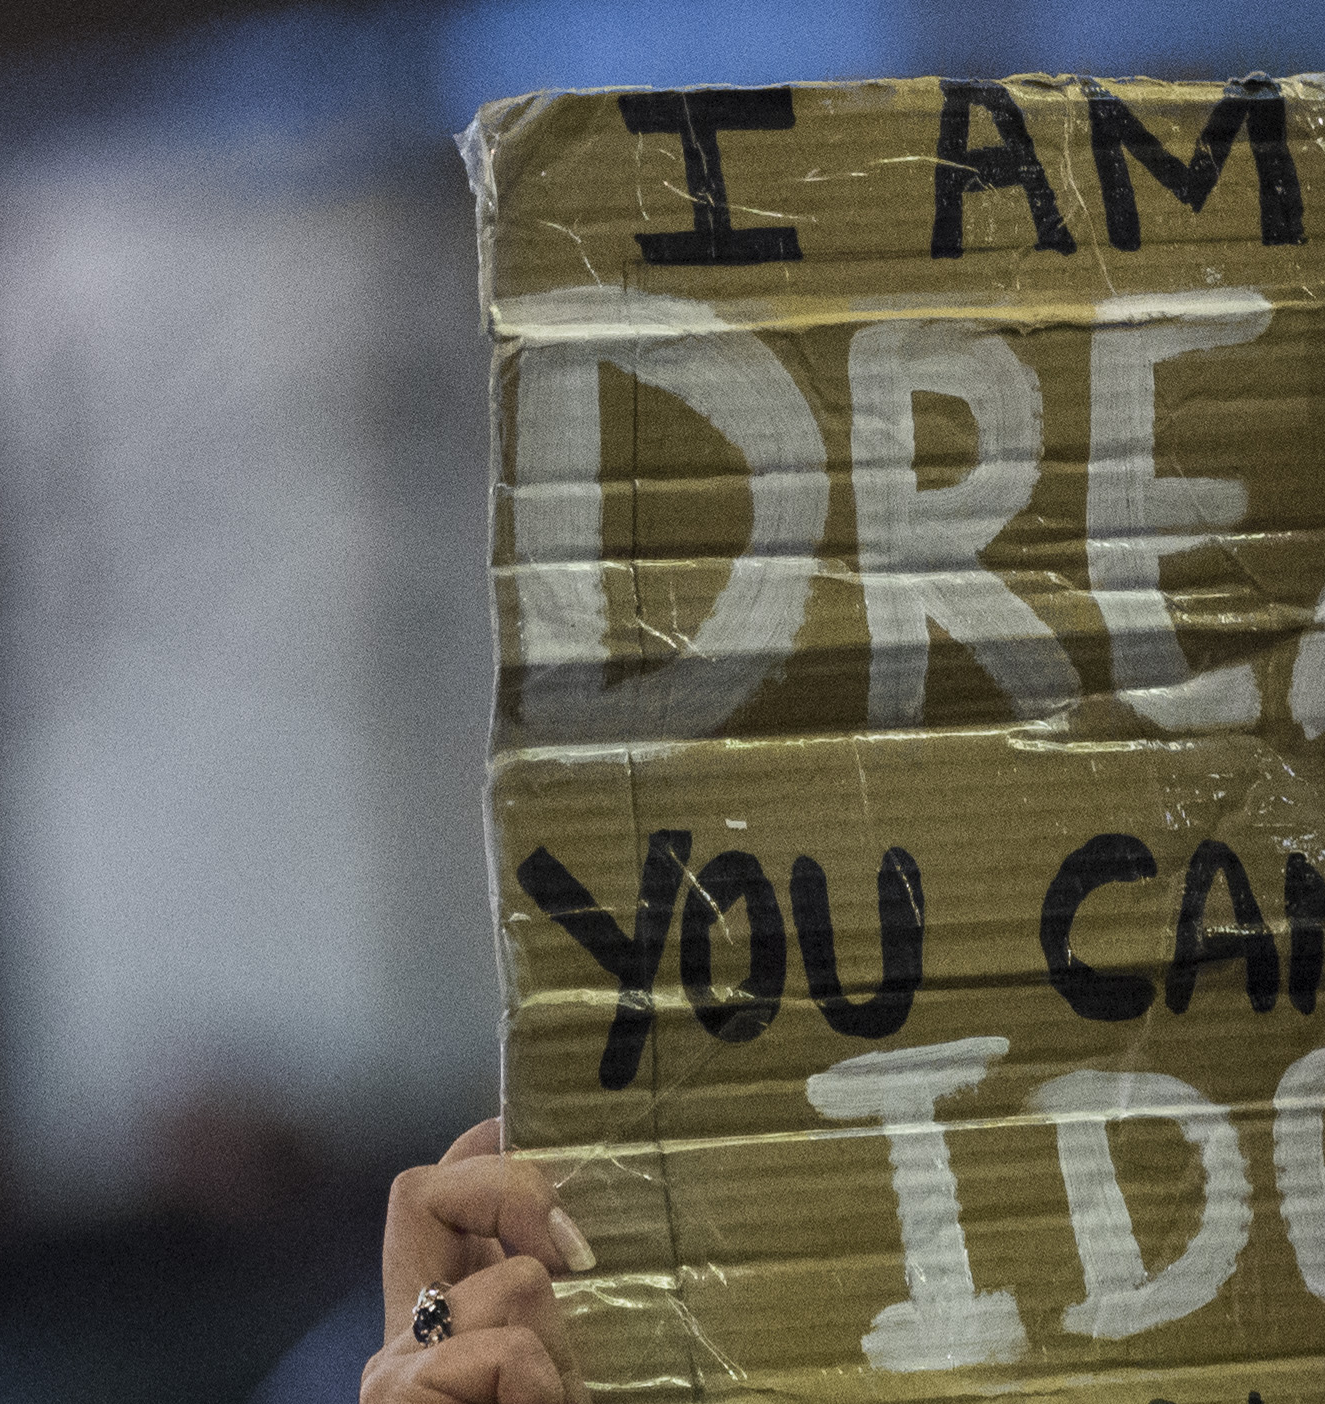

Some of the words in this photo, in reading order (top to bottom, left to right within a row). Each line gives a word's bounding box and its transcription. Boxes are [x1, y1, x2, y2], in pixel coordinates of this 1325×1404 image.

[618, 86, 803, 264] I
[931, 74, 1307, 259] AM
[516, 830, 925, 1090] YOU
